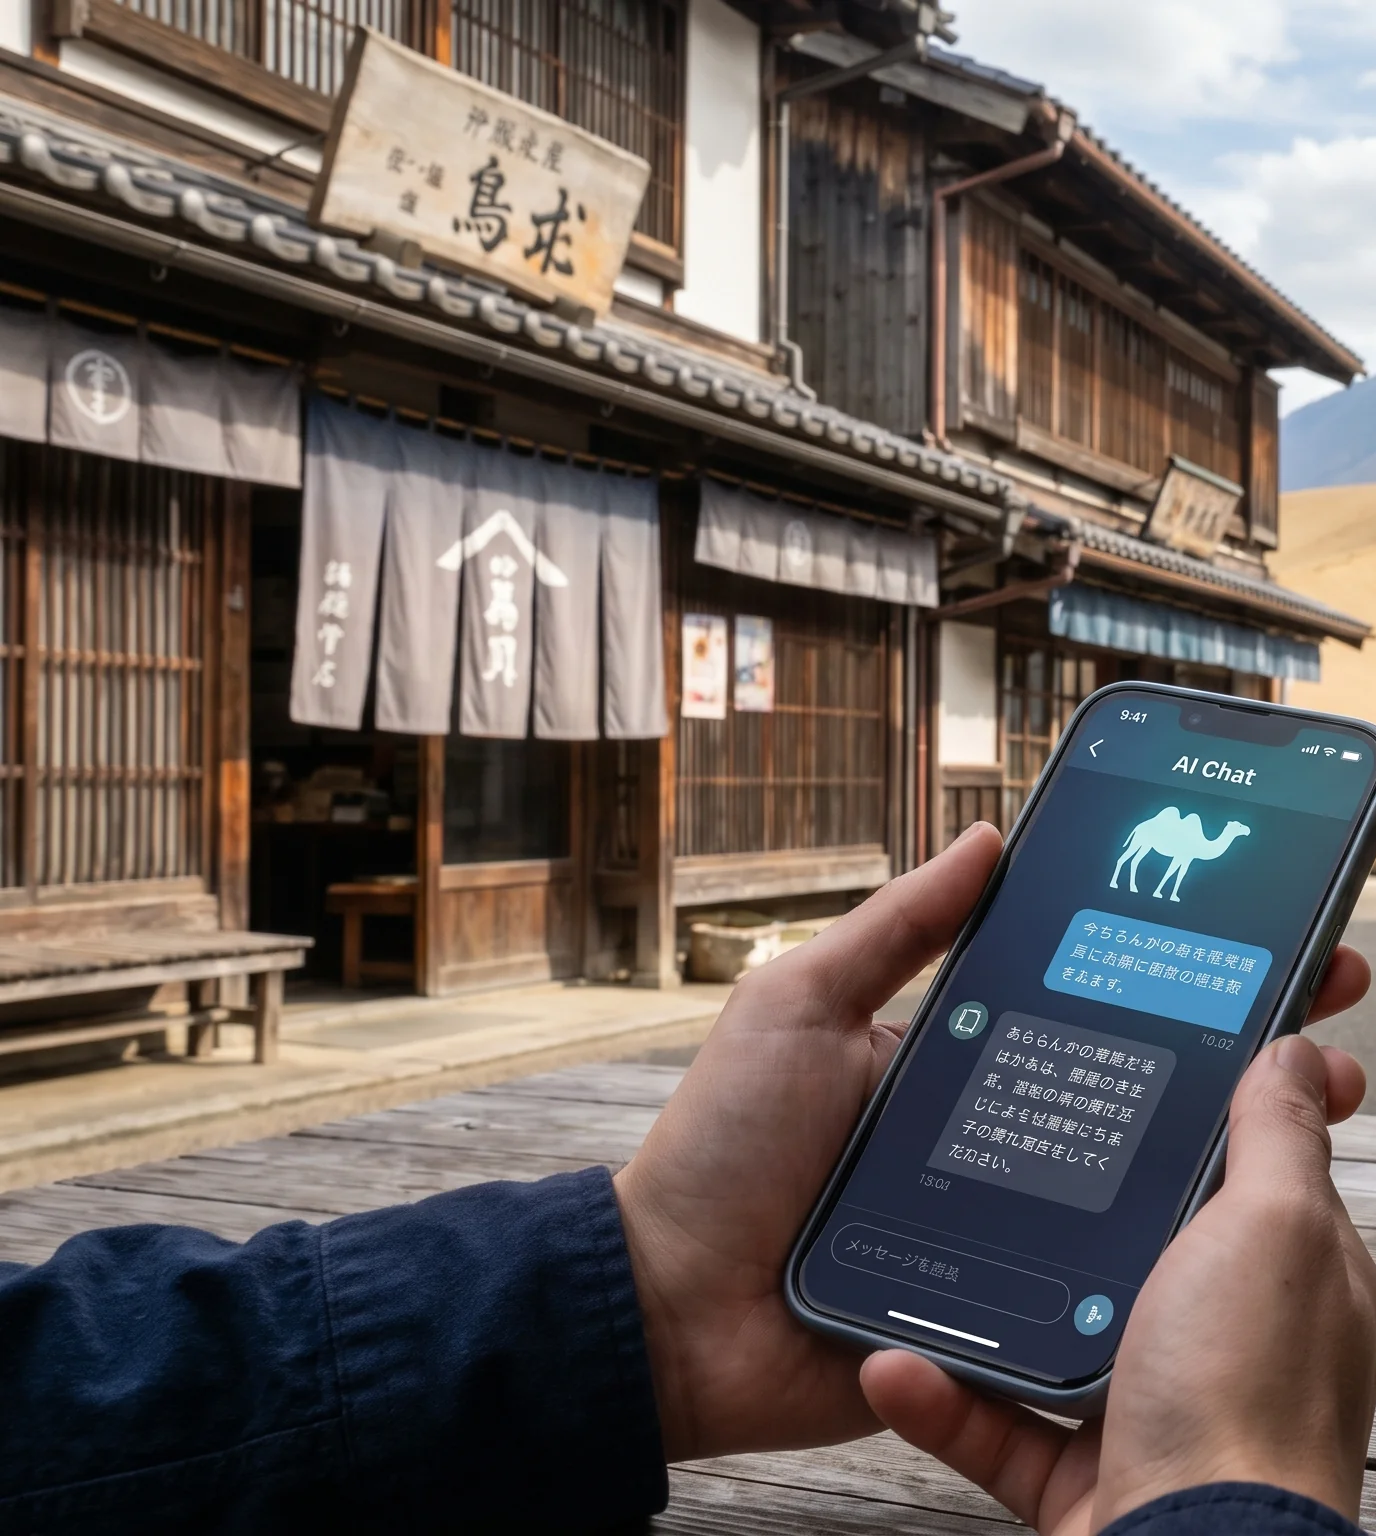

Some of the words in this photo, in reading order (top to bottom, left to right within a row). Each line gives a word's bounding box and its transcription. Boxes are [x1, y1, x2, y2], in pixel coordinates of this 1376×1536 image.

[1120, 709, 1148, 724] 9:41
[1171, 755, 1199, 775] AI
[1202, 760, 1257, 786] Chat
